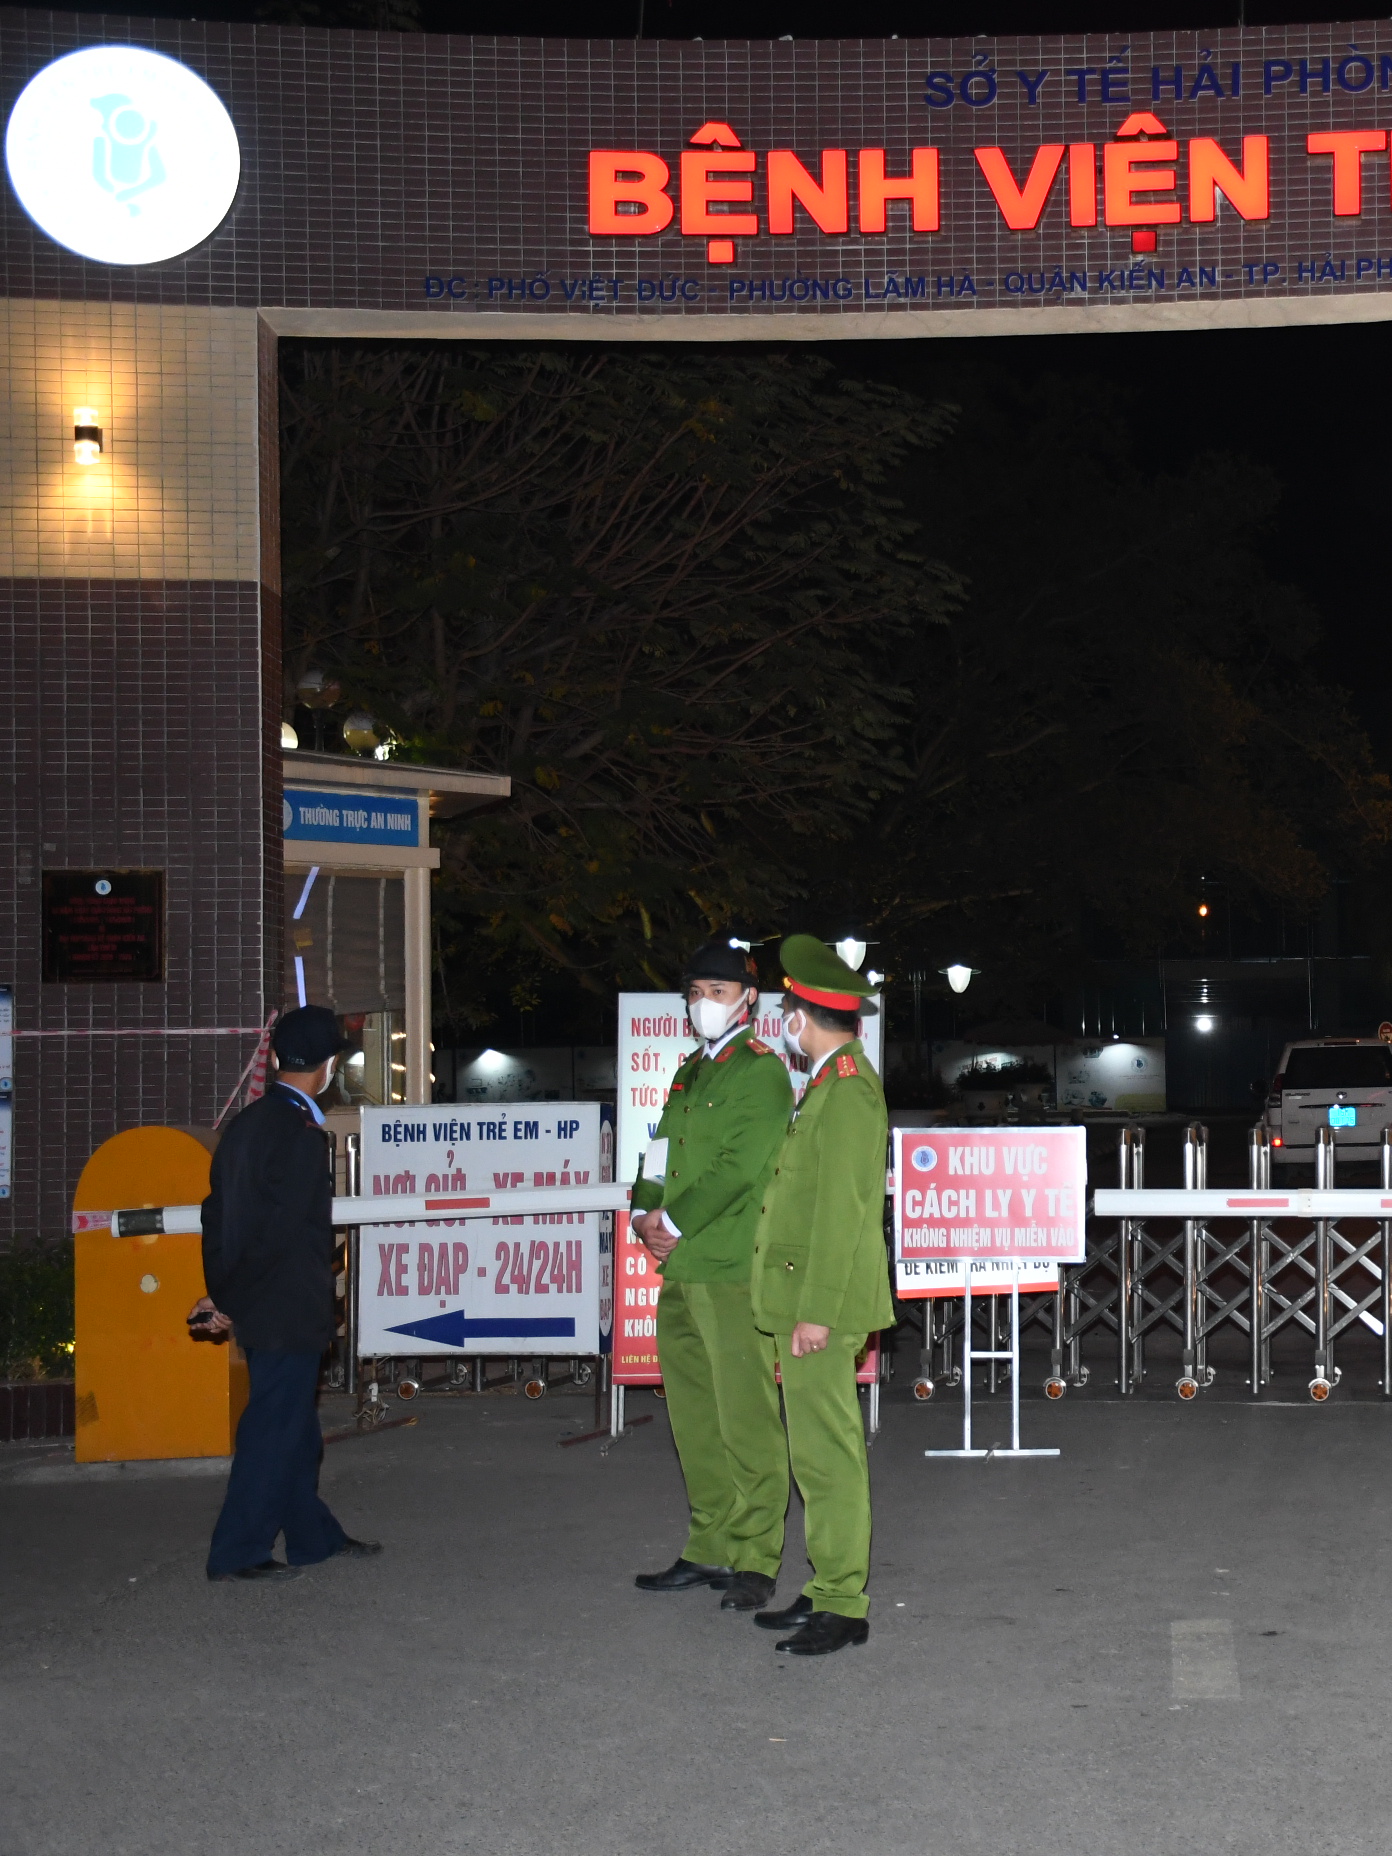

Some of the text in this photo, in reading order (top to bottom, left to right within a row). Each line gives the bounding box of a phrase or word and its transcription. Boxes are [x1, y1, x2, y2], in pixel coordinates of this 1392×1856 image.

[923, 54, 999, 110] SỞ
[1016, 70, 1050, 106] Y
[1066, 45, 1131, 105] TẾ
[1151, 50, 1241, 102] HẢI
[587, 121, 940, 265] BỆNH
[972, 111, 1269, 254] VIỆN
[487, 269, 552, 300] PHỐ
[636, 271, 700, 301] ĐỨC
[728, 268, 853, 301] PHƯỜNG
[863, 270, 927, 301] LÃM
[1099, 254, 1166, 293] KIẾN
[1176, 265, 1218, 290] AN
[1242, 262, 1288, 287] TP.
[1298, 253, 1346, 285] HẢI
[299, 803, 411, 832] THƯỜNG TRỰC AN NINH
[631, 1012, 678, 1037] NGƯỜI
[631, 1044, 666, 1075] SỐT,
[630, 1083, 658, 1107] TỨC
[381, 1119, 427, 1147] BỆNH
[433, 1118, 471, 1146] VIỆN
[477, 1112, 507, 1140] TRẺ
[513, 1120, 539, 1140] EM
[557, 1119, 580, 1140] HP
[948, 1143, 1048, 1181] KHU VỰC
[905, 1180, 1075, 1218] CÁCH LY Y TẾ
[904, 1220, 1075, 1250] KHÔNG NHIỆM VỤ MIỄN VÀO
[377, 1243, 410, 1297] XE
[416, 1242, 469, 1309] ĐẠP
[494, 1240, 583, 1295] 24/24H
[625, 1253, 647, 1276] CÓ
[621, 1353, 640, 1364] LIÊN
[641, 1353, 651, 1365] HỆ
